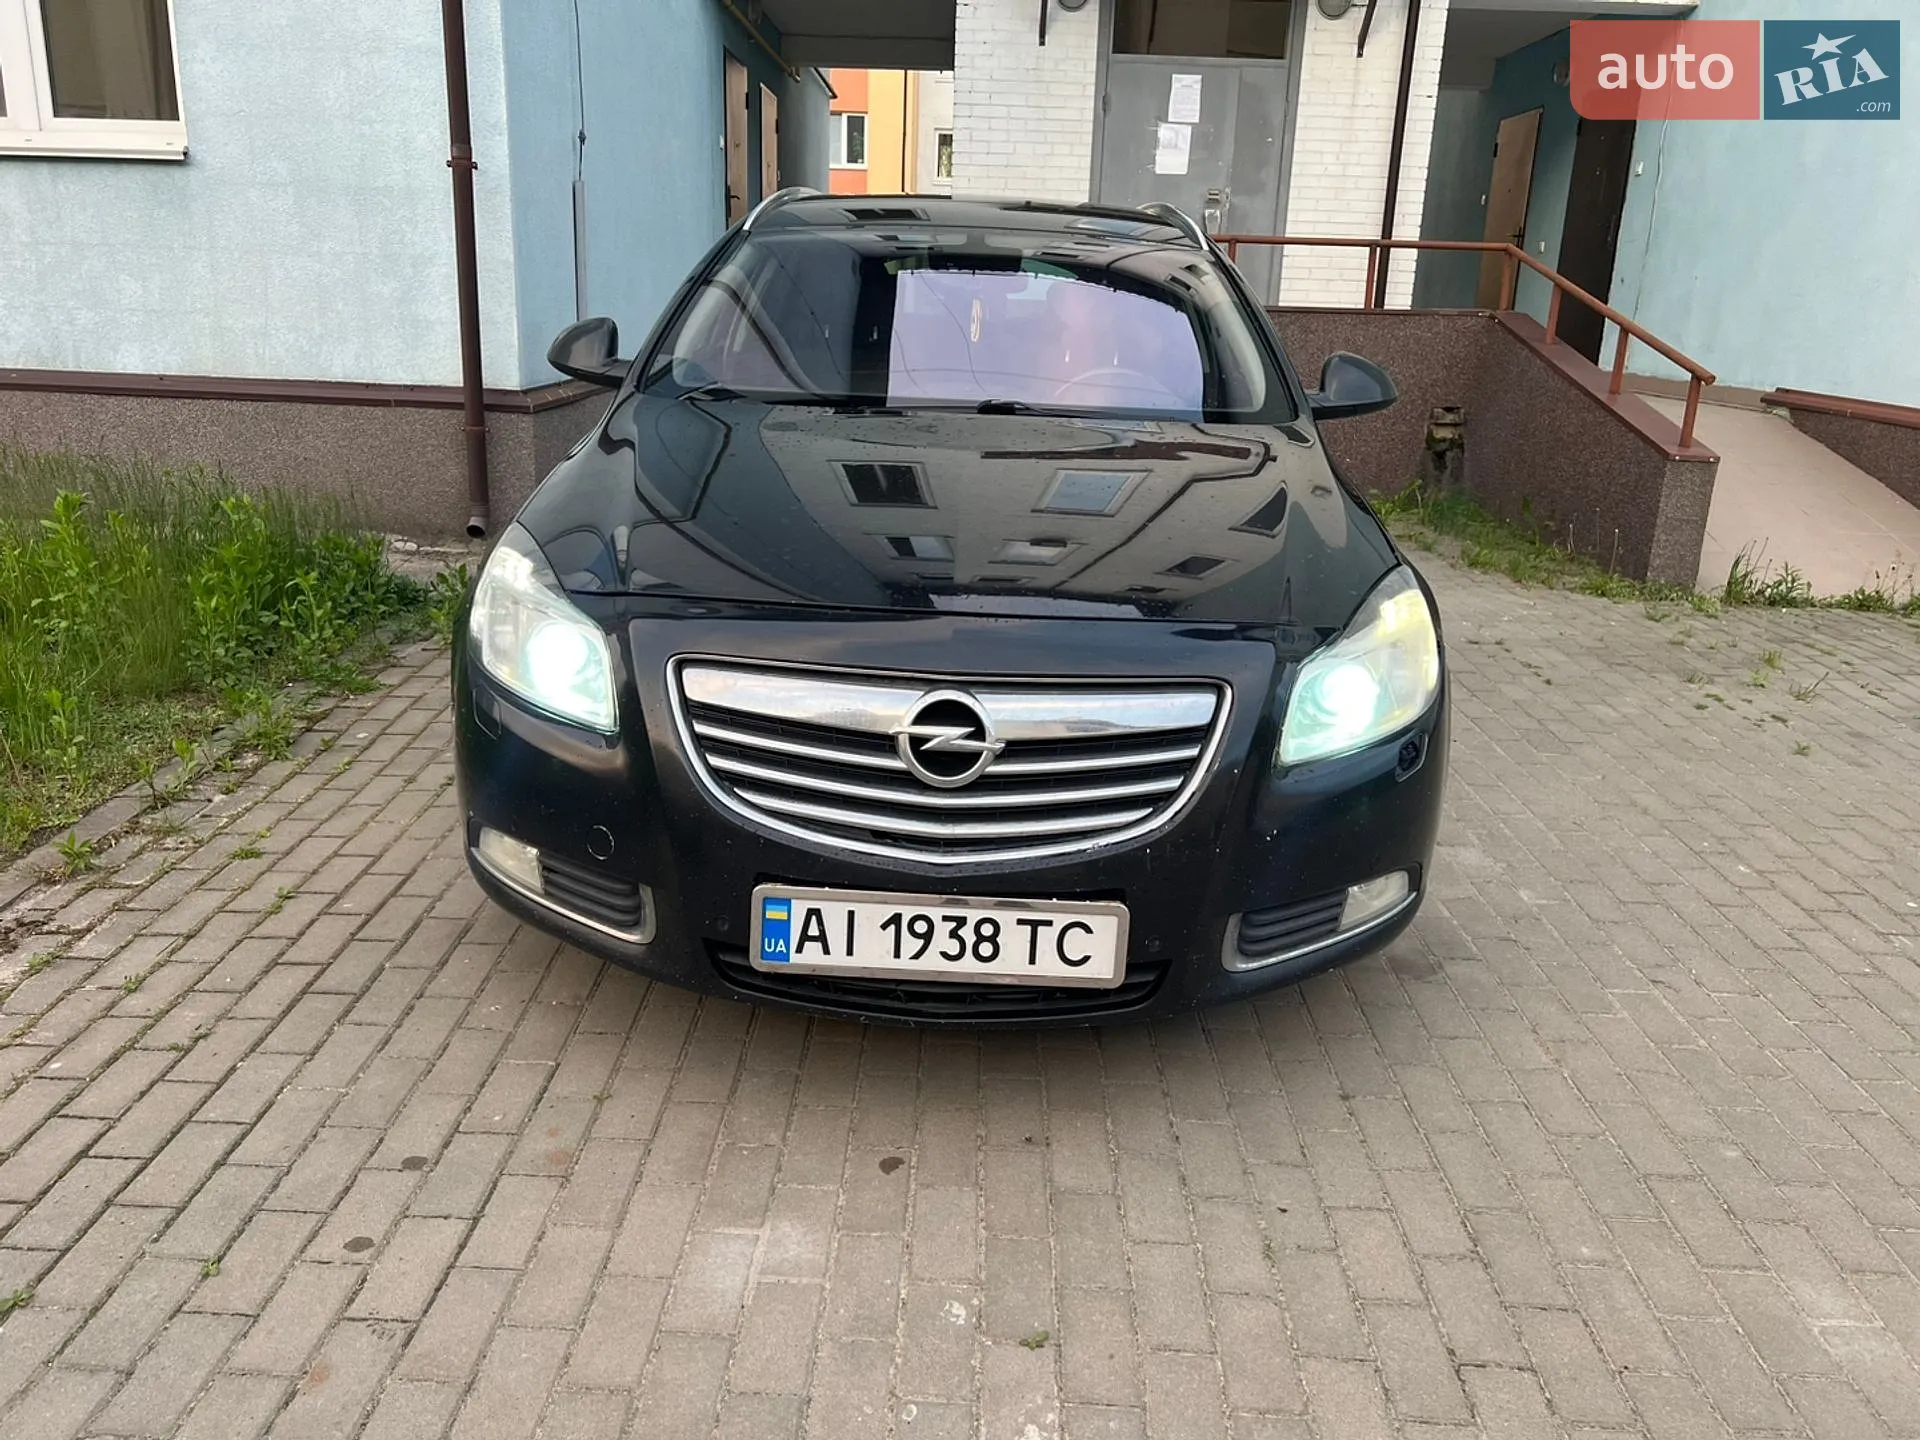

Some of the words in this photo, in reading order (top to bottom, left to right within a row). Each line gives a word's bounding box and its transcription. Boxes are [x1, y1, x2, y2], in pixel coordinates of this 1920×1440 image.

[764, 937, 787, 954] UA
[794, 907, 856, 957] AI
[880, 912, 1001, 963] 1938
[1016, 917, 1095, 967] TC
